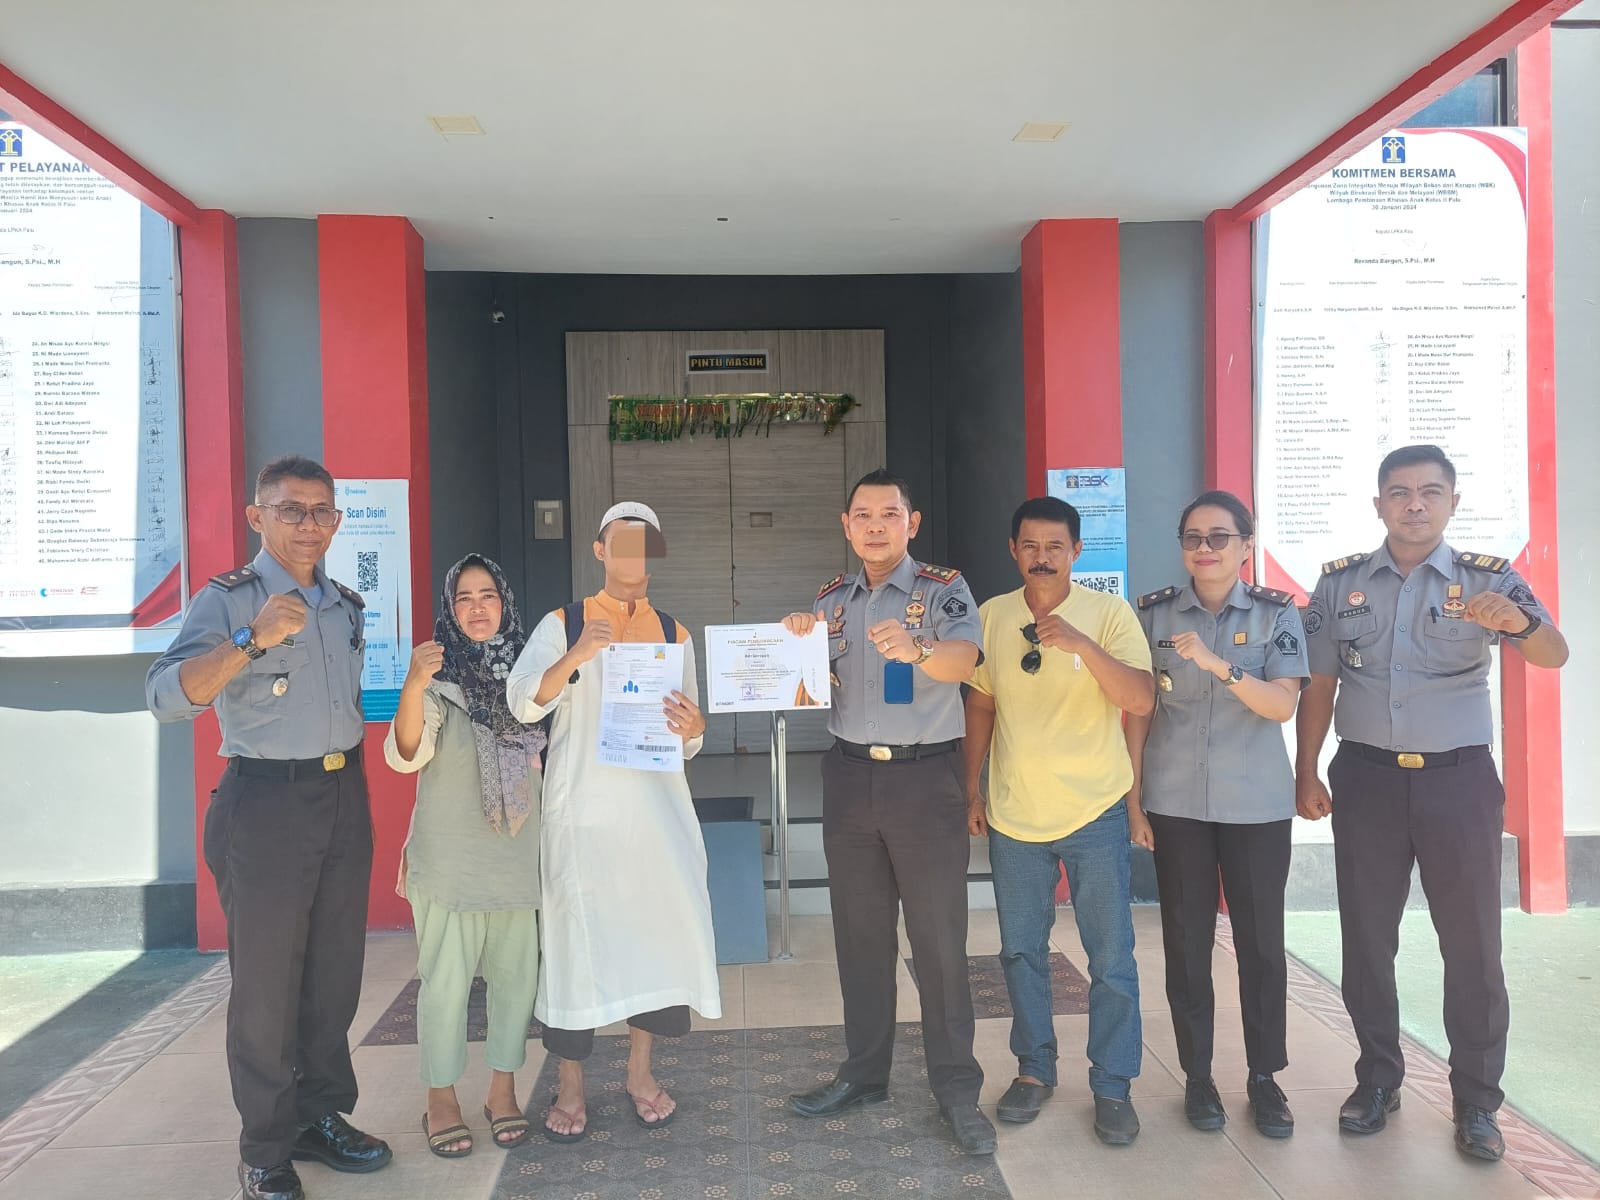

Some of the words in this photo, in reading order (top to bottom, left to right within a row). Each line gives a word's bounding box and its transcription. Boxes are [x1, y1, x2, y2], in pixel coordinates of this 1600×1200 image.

[10, 162, 91, 172] PELAYANAN
[1332, 169, 1396, 178] KOMITMEN
[1399, 168, 1456, 178] BERSAMA
[690, 357, 723, 369] PINTU
[725, 356, 765, 368] MASUK
[346, 506, 365, 519] Scan
[366, 506, 387, 519] Disini
